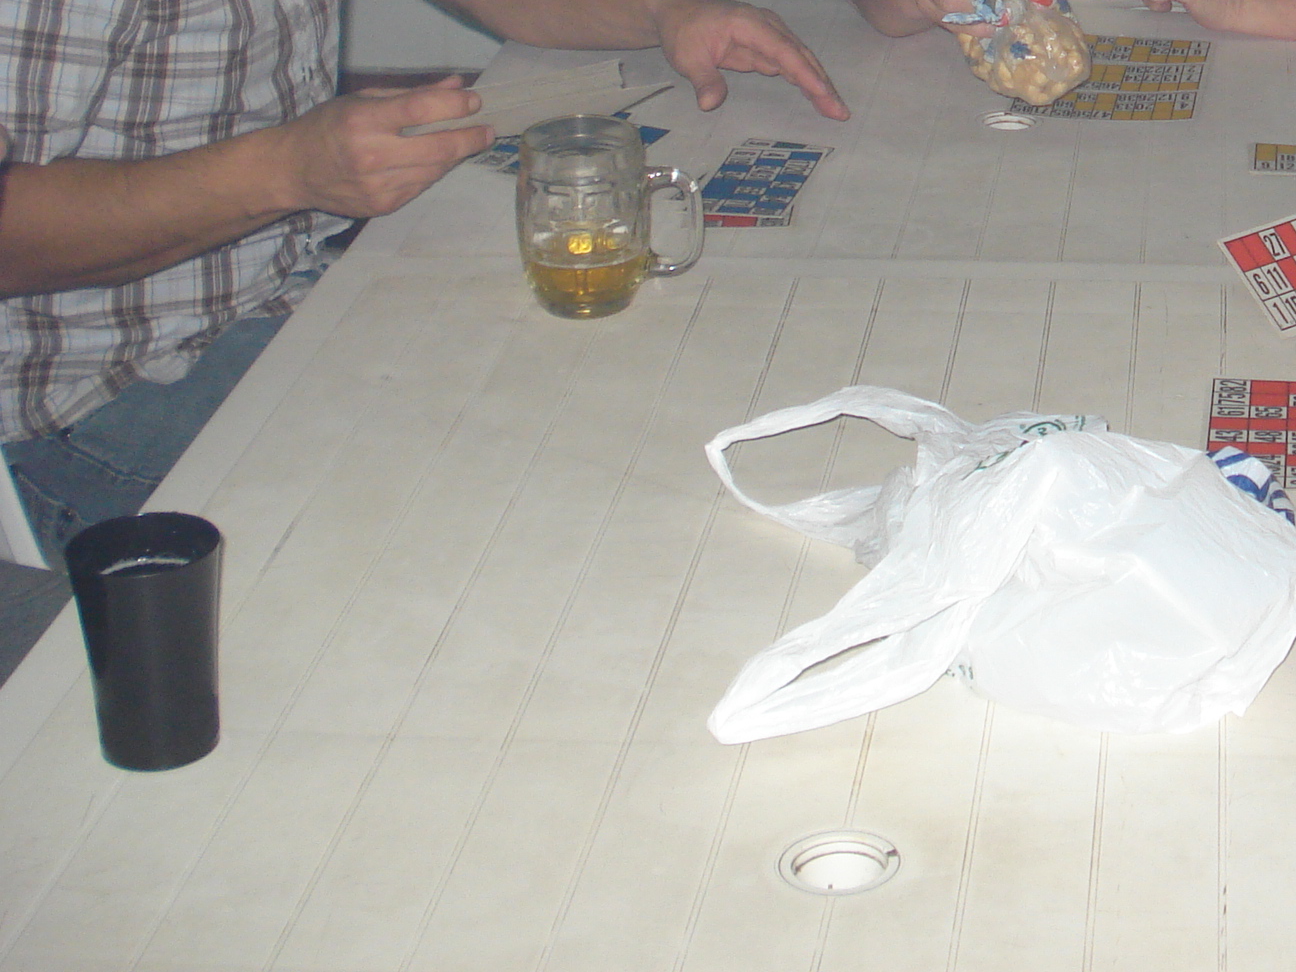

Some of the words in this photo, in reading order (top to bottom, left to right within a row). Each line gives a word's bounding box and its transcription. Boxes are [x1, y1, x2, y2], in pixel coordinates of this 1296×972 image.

[1264, 233, 1285, 256] 27
[1253, 274, 1269, 295] 6
[1267, 267, 1289, 291] 11
[1273, 302, 1289, 325] 1
[1221, 380, 1246, 391] 82
[1219, 393, 1246, 404] 75
[1217, 406, 1245, 416] 61
[1255, 407, 1282, 418] 65
[1215, 431, 1243, 441] 43
[1255, 431, 1283, 442] 48
